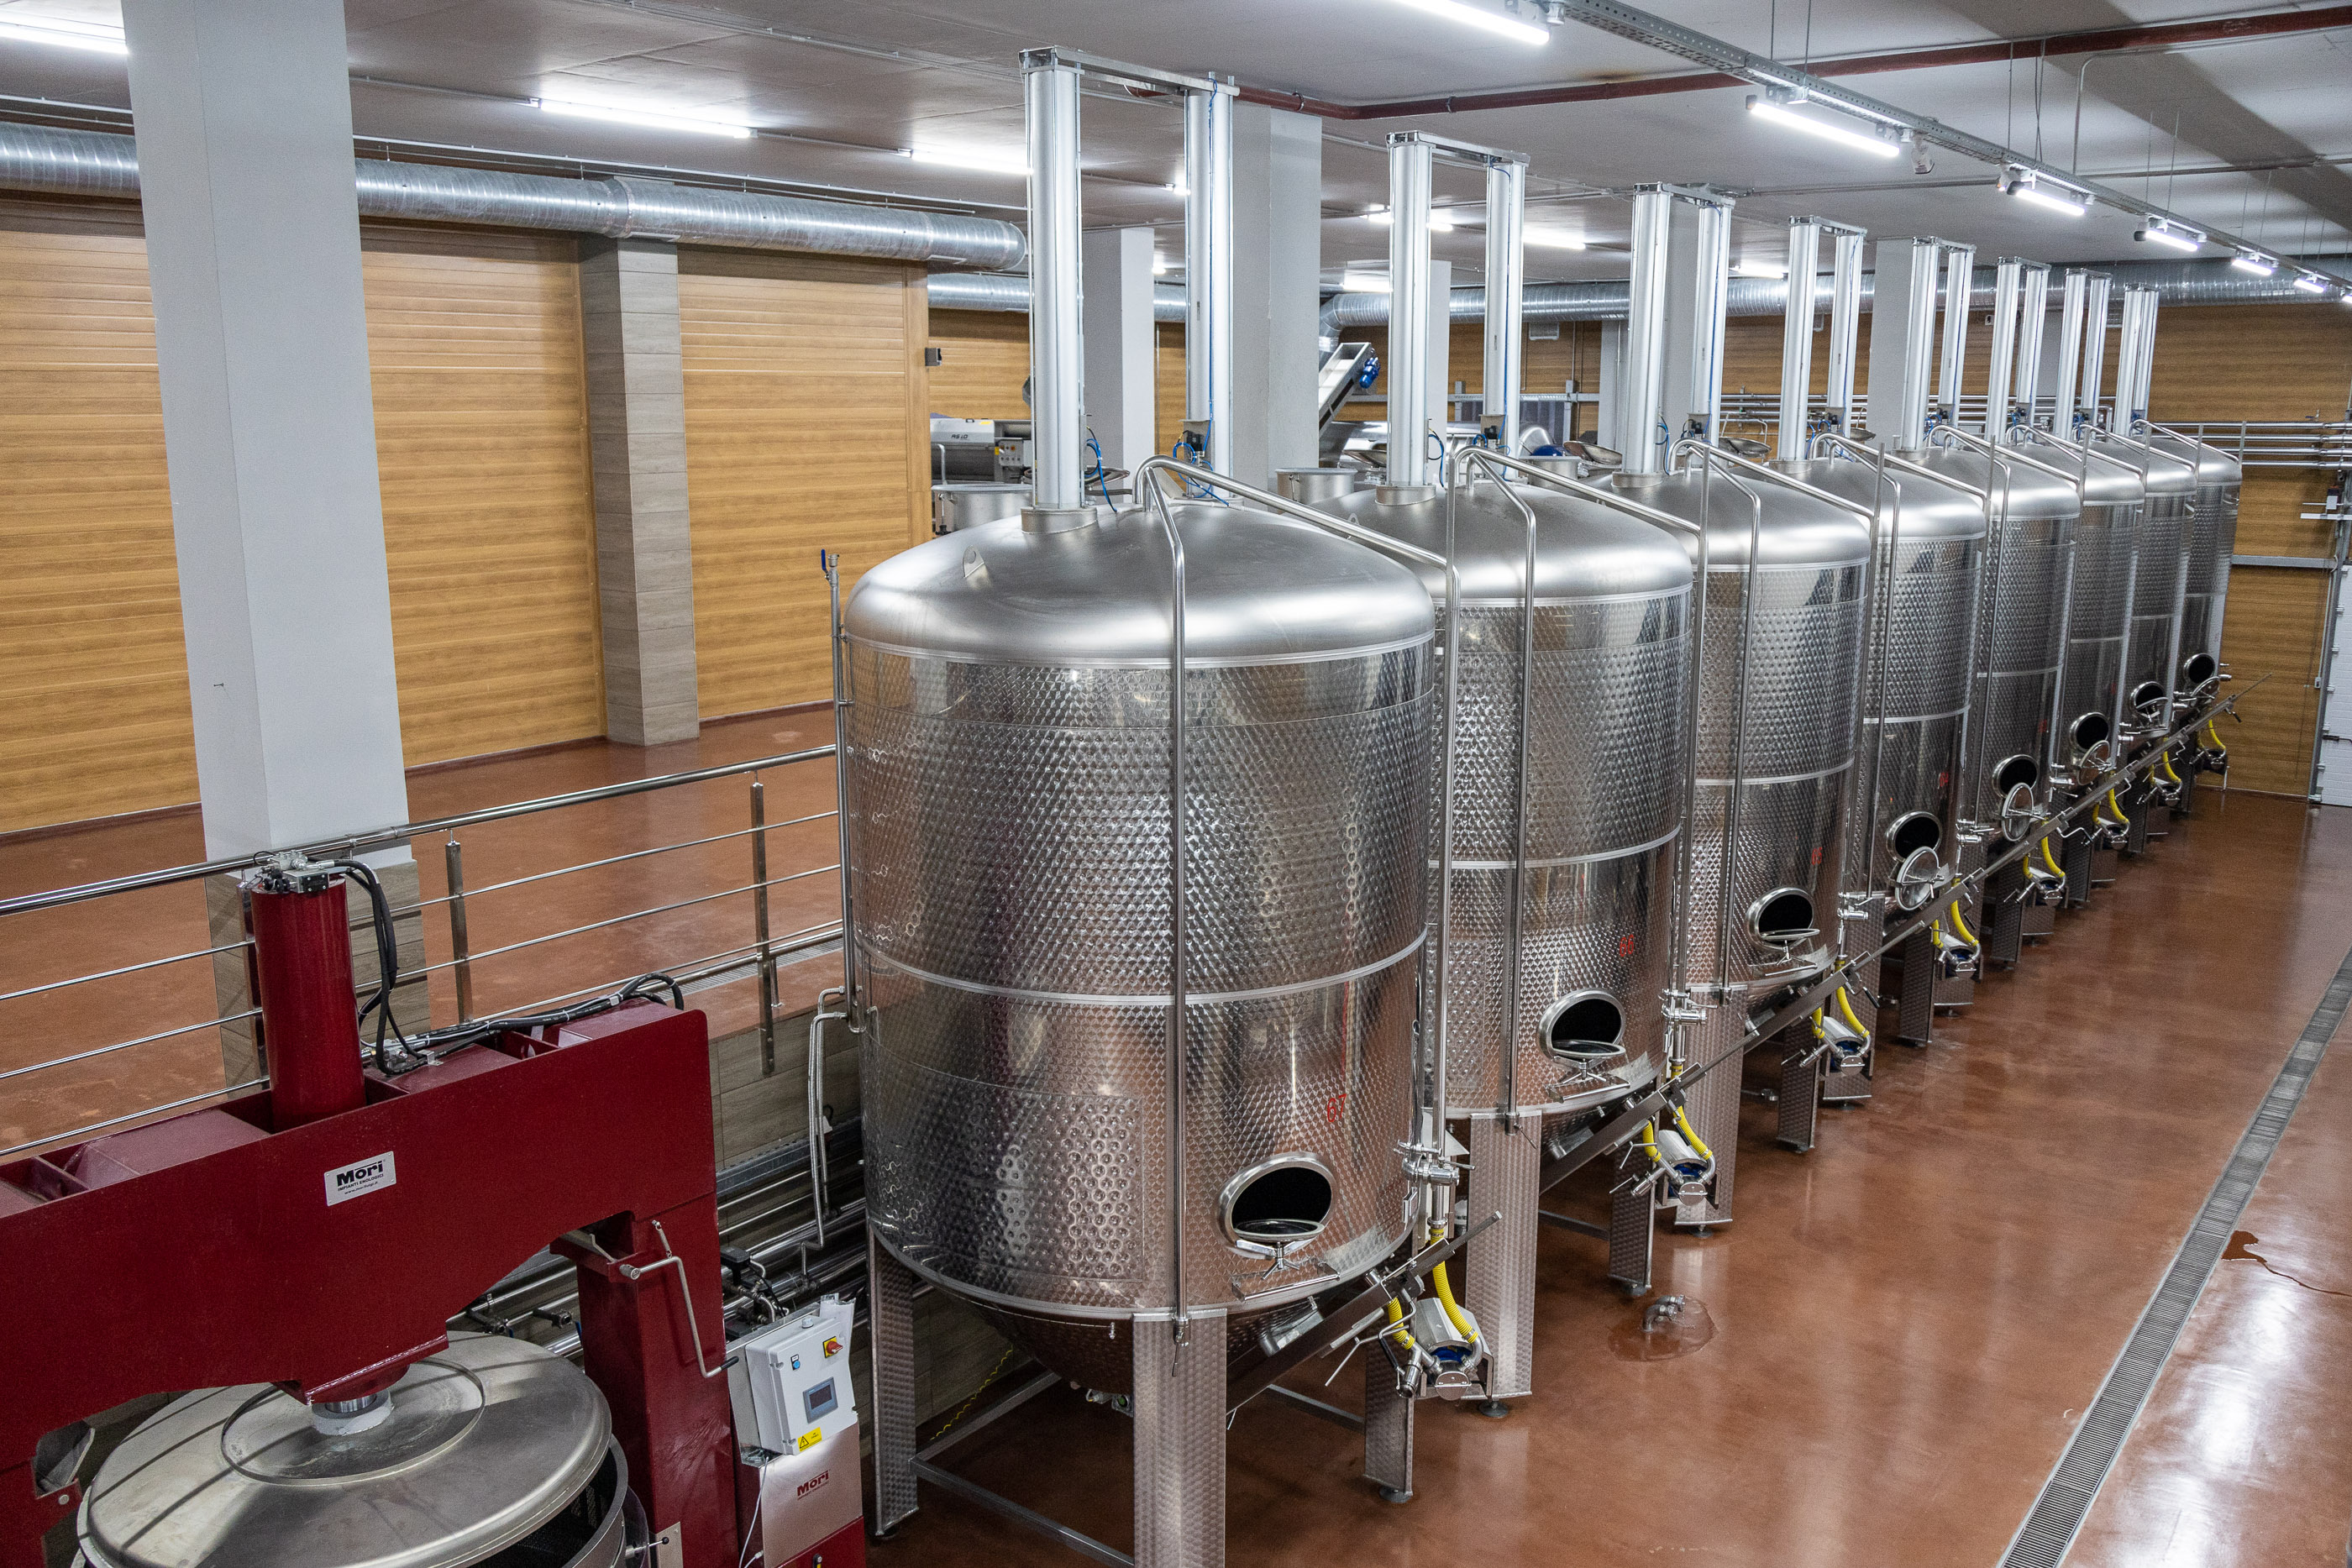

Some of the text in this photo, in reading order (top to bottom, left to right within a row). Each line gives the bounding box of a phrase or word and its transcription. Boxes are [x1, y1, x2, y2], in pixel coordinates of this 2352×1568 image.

[1812, 847, 1822, 865] 65
[1620, 934, 1634, 957] 66
[1327, 1093, 1347, 1122] 67
[337, 1161, 383, 1187] Mori
[338, 1173, 384, 1192] IMPIANTI ENOLOGICI
[797, 1470, 829, 1497] Mori
